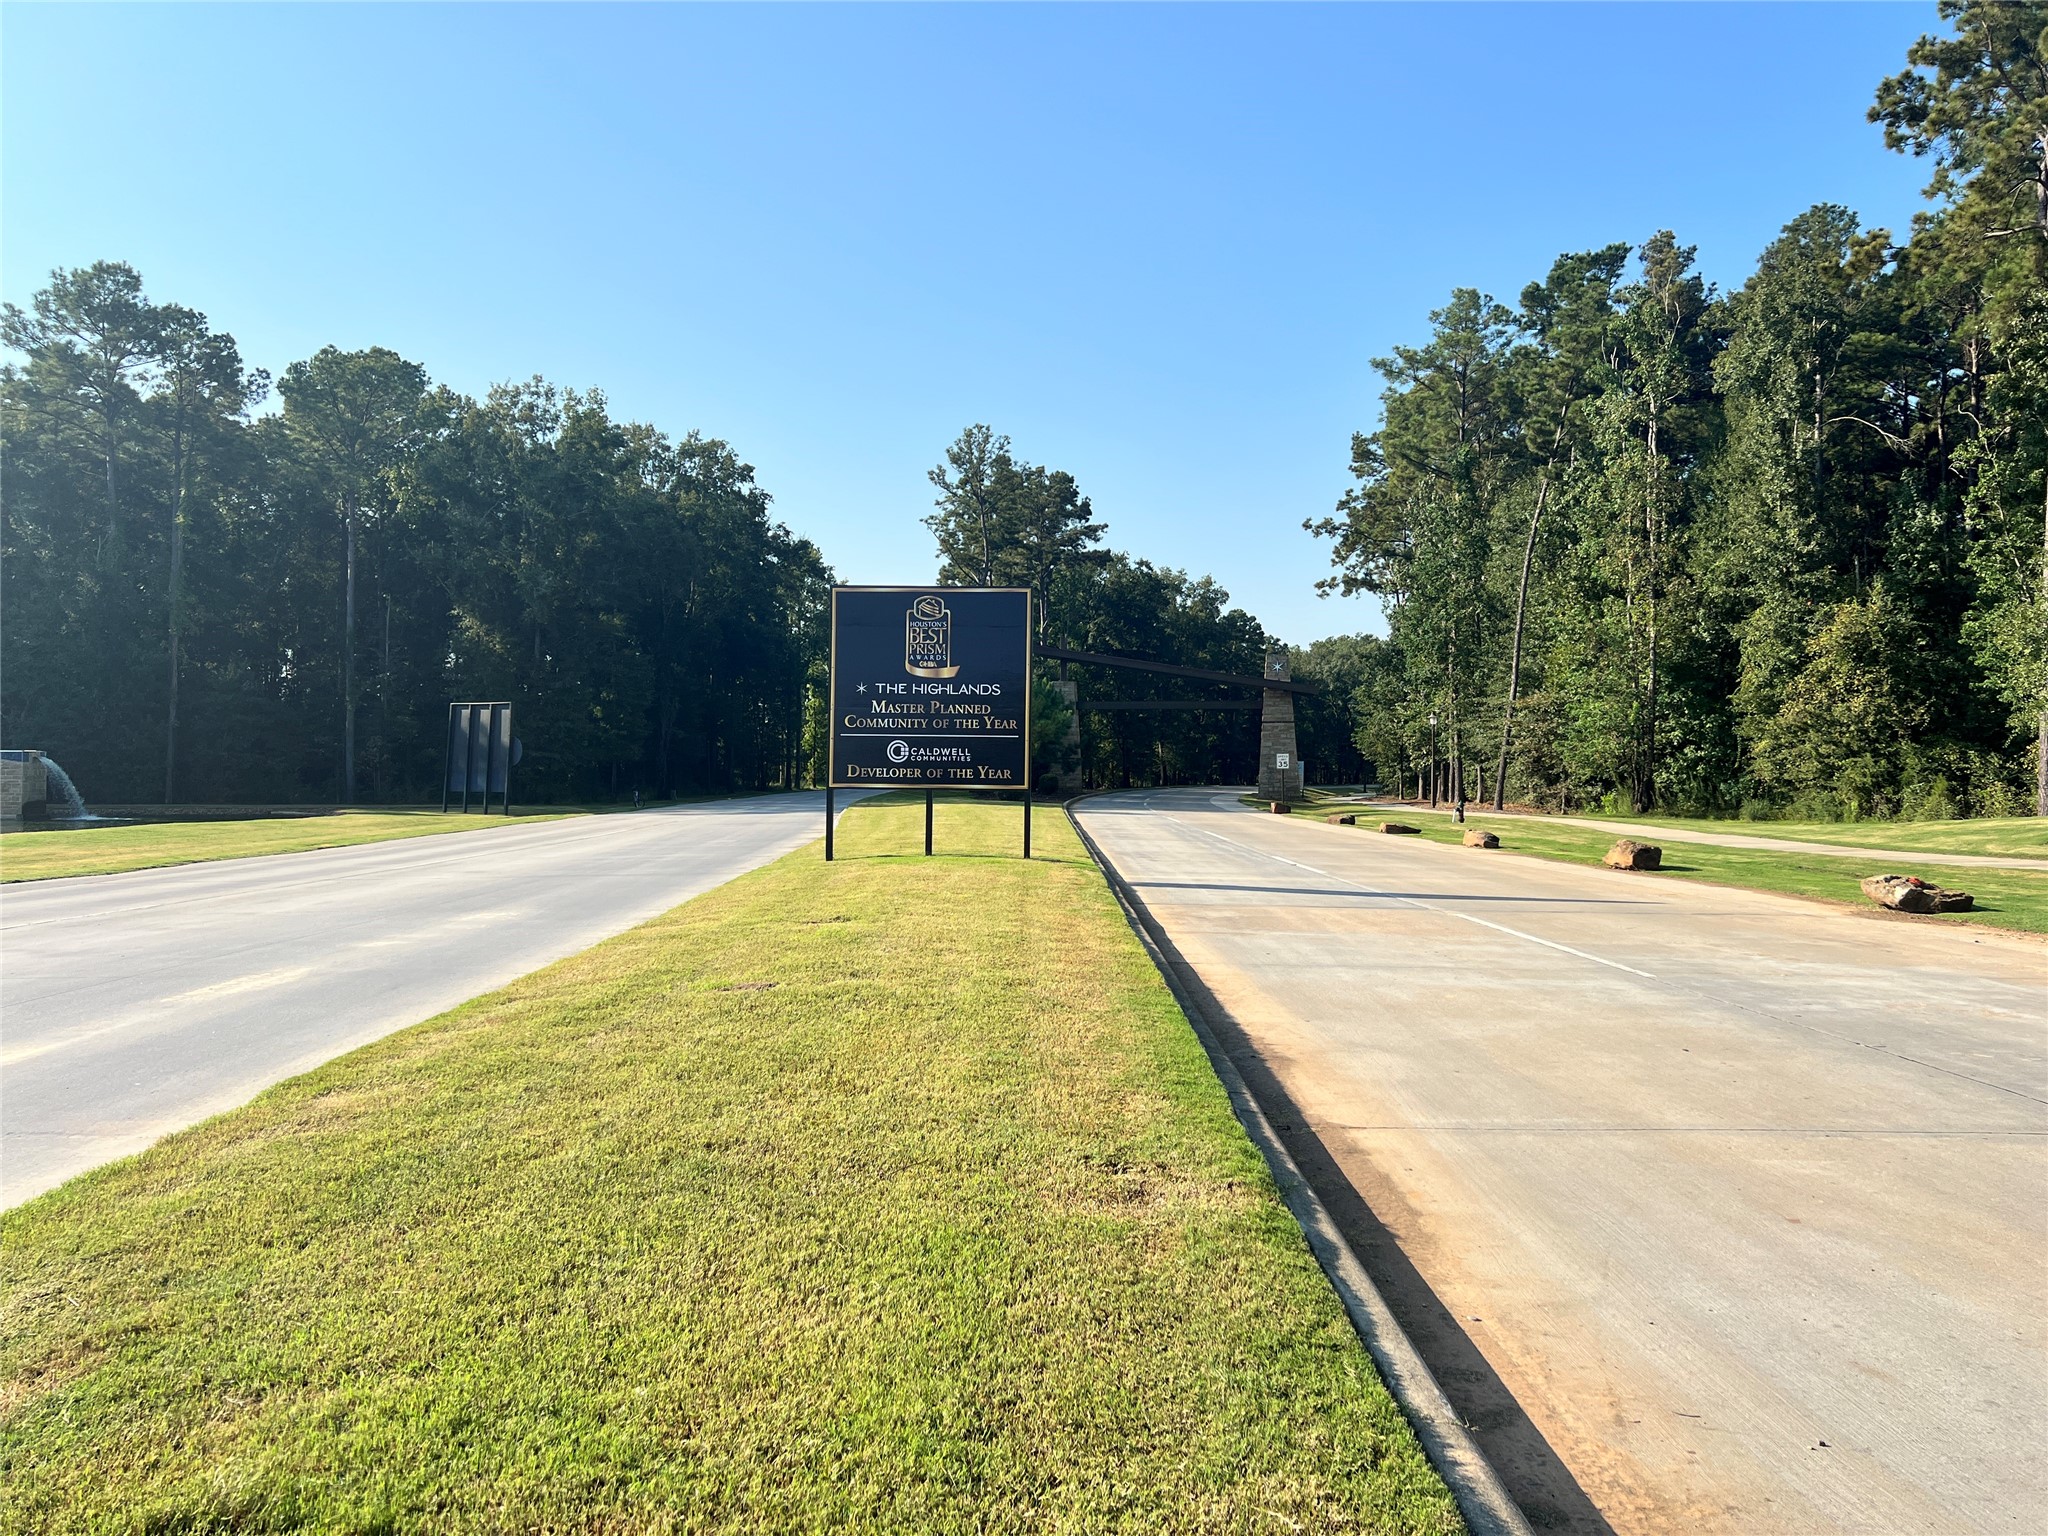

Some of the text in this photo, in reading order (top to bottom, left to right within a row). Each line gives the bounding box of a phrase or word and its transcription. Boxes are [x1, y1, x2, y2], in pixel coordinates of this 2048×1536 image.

[910, 628, 947, 644] BEST
[910, 644, 946, 654] PRISM
[875, 683, 1001, 695] THE HIGHLANDS
[933, 718, 949, 728] OF
[954, 719, 979, 728] THE
[911, 748, 971, 756] CALDWELL
[927, 769, 943, 778] OF
[948, 769, 974, 778] THE
